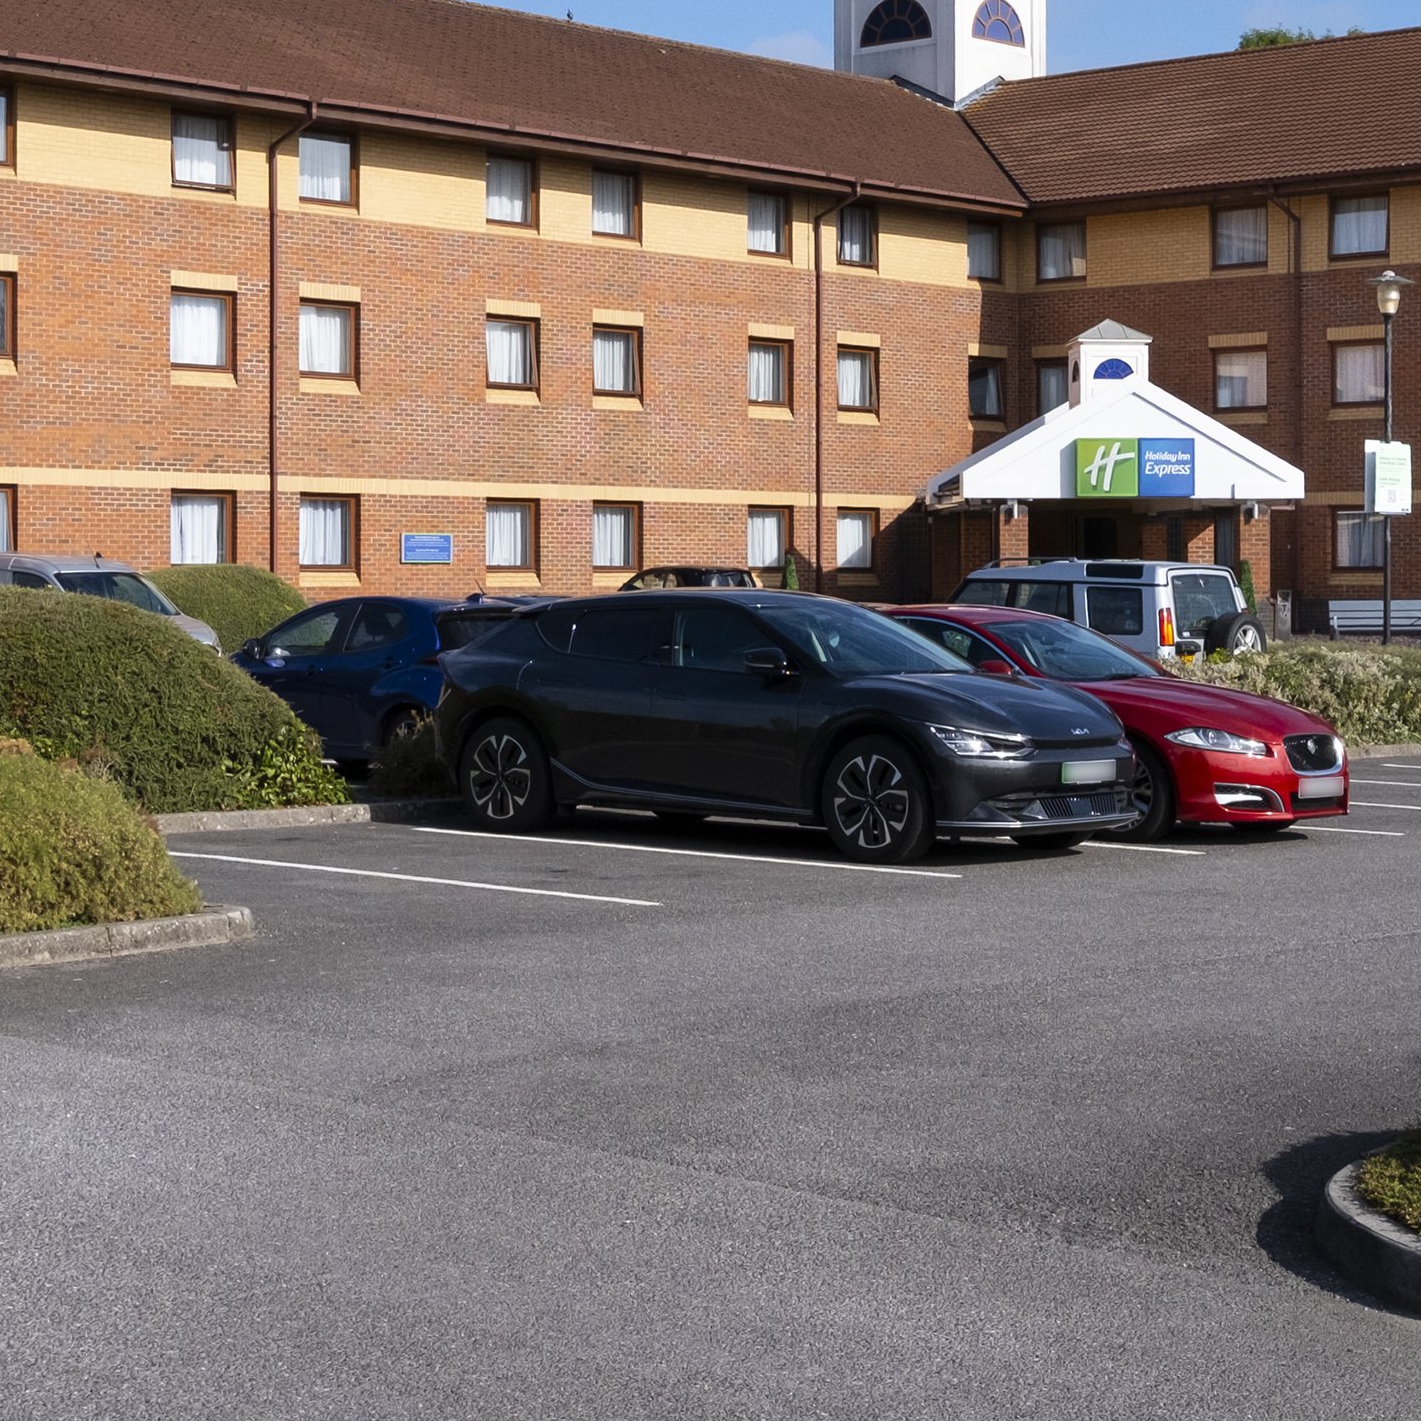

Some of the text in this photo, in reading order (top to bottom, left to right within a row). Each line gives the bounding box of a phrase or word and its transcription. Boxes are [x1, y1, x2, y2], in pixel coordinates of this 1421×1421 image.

[1145, 451, 1191, 462] Holiday Inn
[1145, 462, 1191, 478] Express
